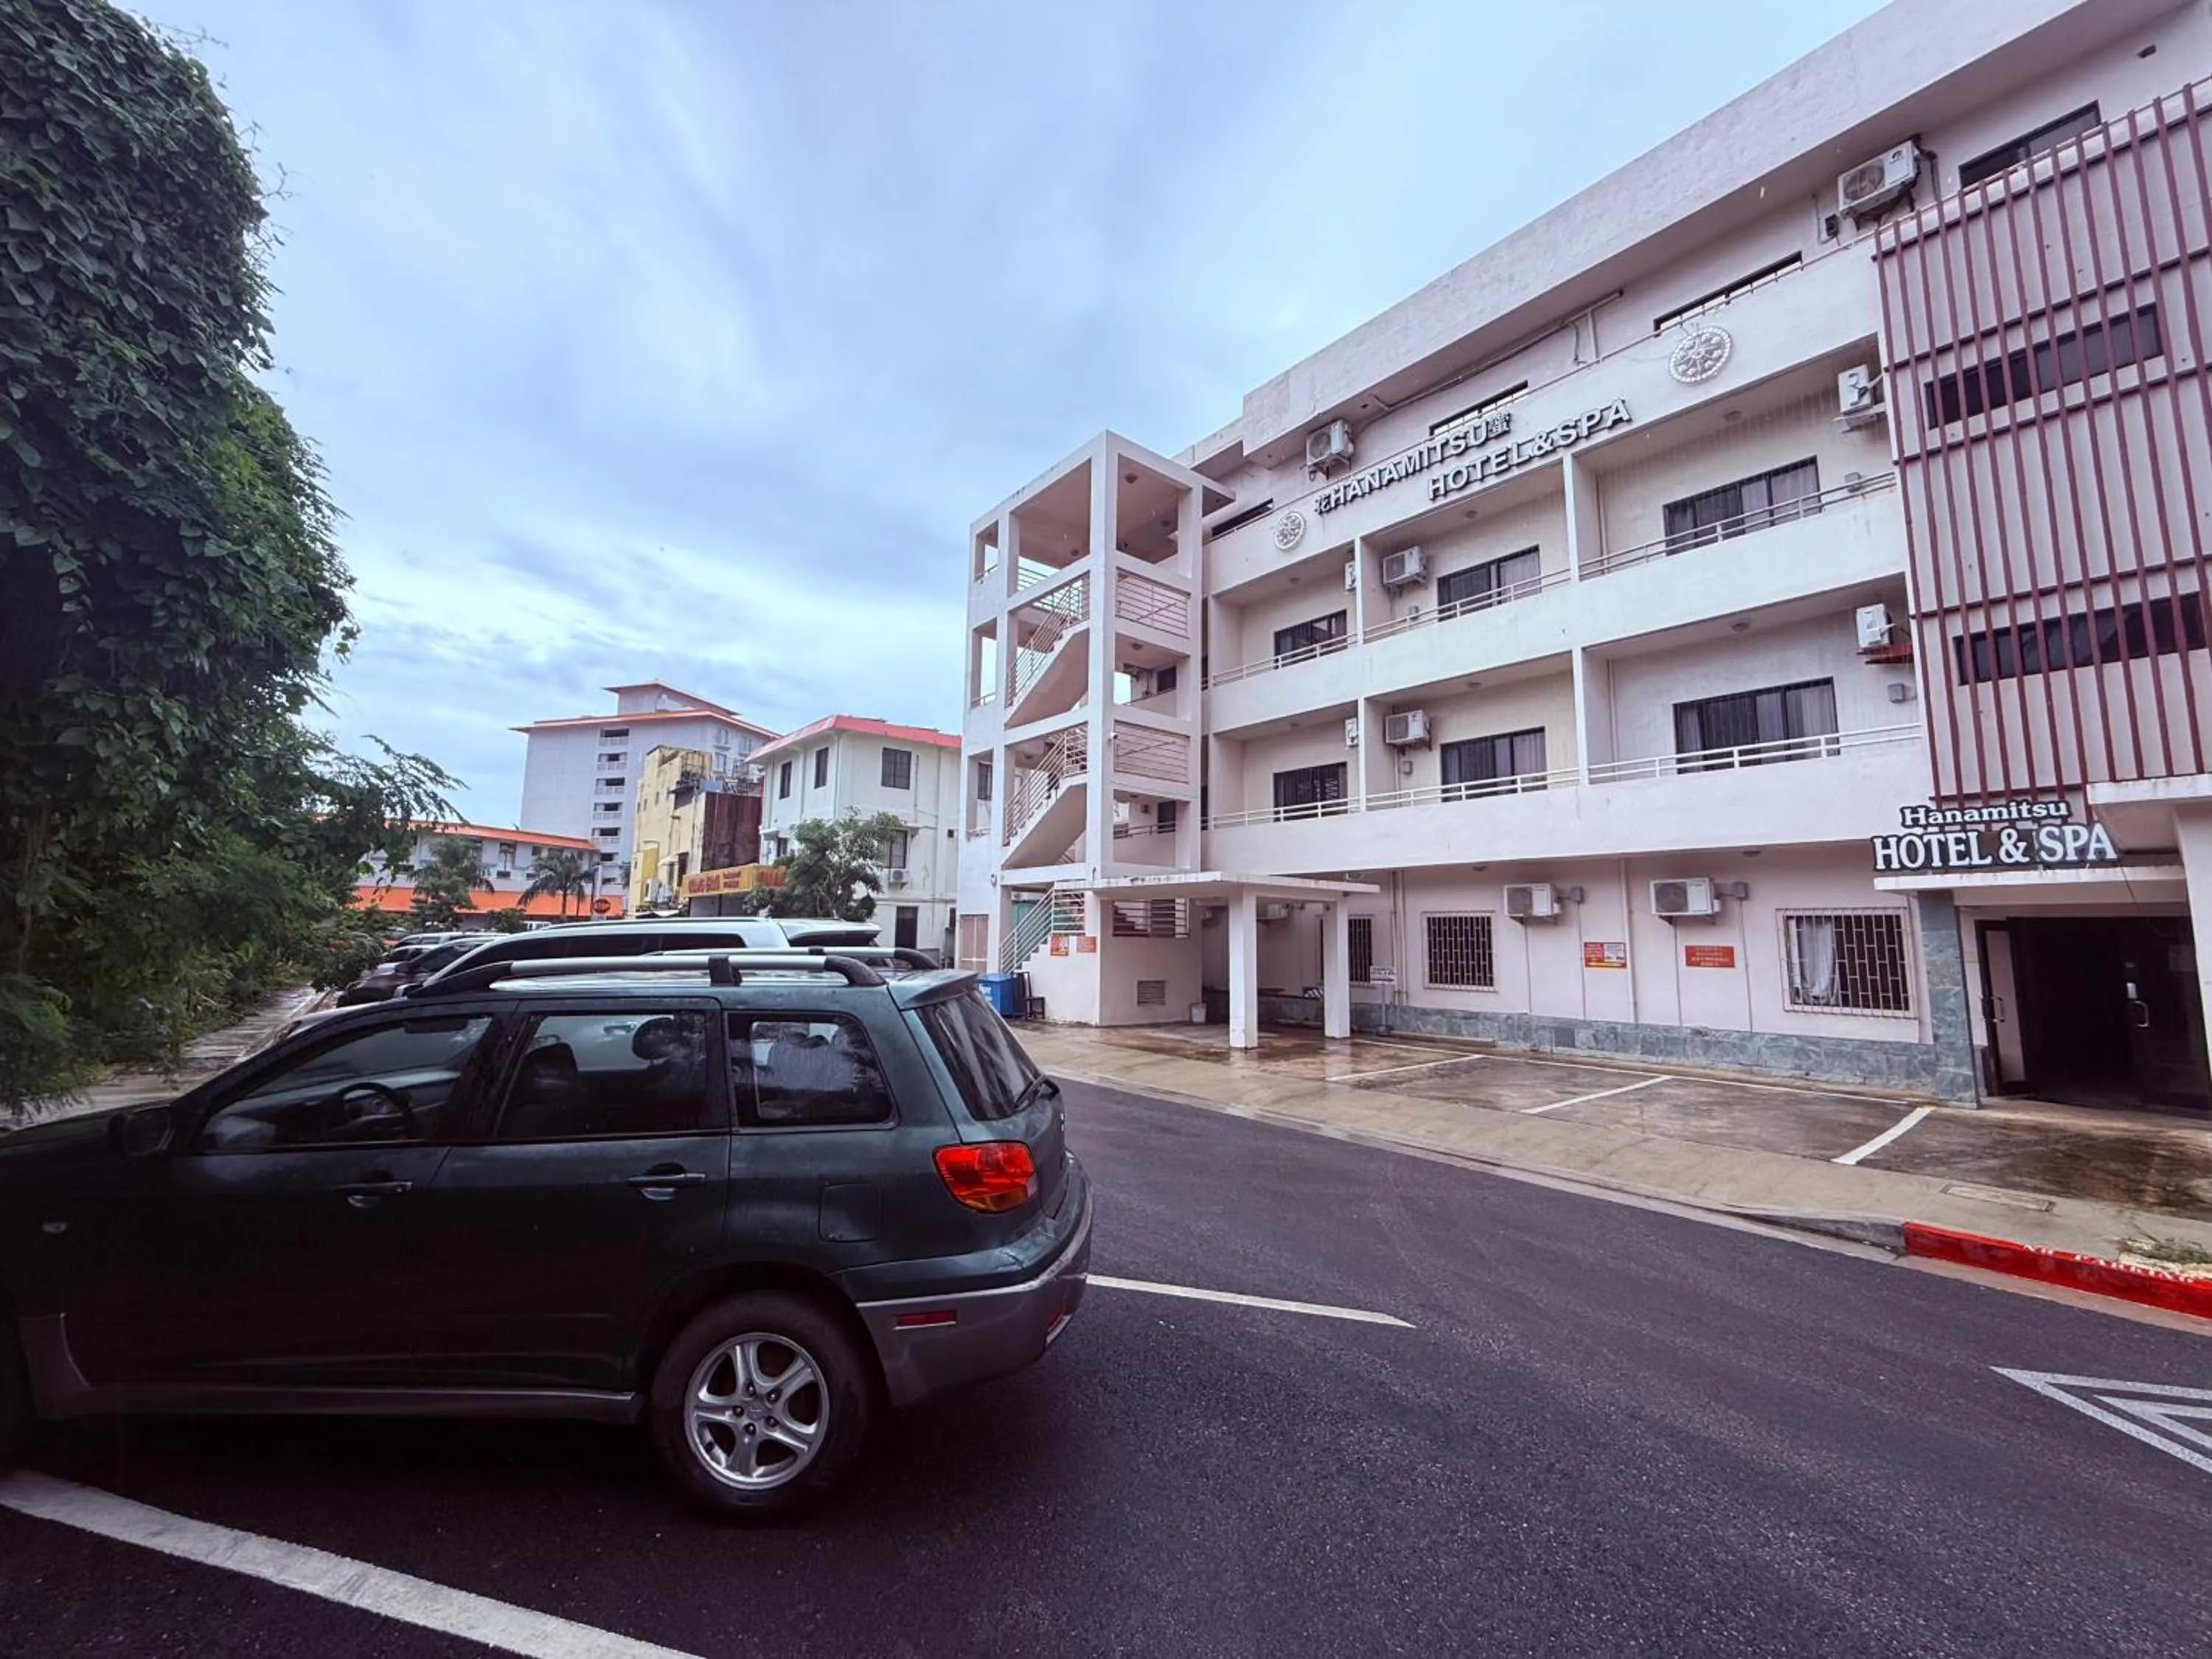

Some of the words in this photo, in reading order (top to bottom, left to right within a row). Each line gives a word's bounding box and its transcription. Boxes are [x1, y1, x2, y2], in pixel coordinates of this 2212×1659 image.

[1902, 800, 2069, 827] Hanamitsu
[1872, 831, 1992, 870] HOTEL
[1998, 827, 2030, 864] &
[2038, 822, 2118, 863] SPA
